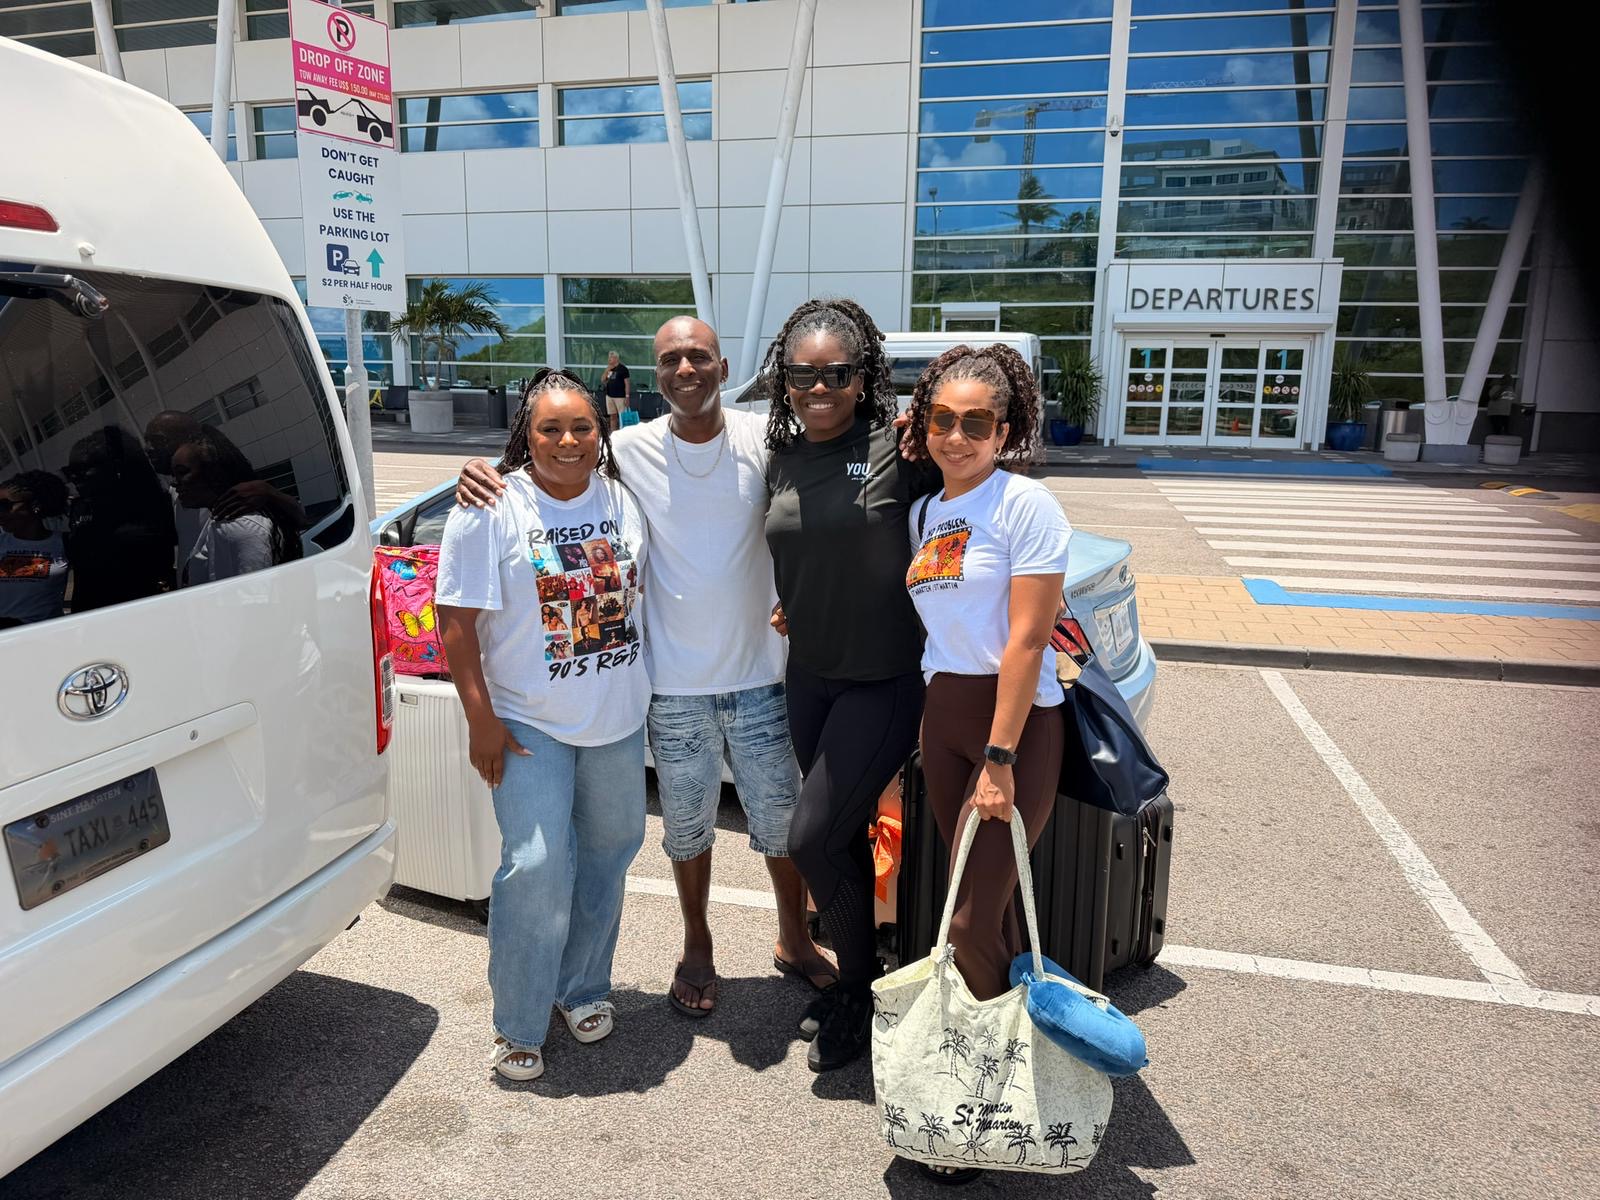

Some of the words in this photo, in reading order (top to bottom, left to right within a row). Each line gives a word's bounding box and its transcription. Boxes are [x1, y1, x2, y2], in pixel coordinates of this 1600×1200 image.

[299, 48, 331, 69] DROP
[335, 58, 354, 76] OFF
[358, 64, 385, 84] ZONE
[299, 69, 312, 81] TOW
[313, 72, 329, 85] AWAY
[329, 77, 338, 88] FEE
[321, 147, 356, 164] DON'T
[359, 155, 379, 168] GET
[328, 168, 375, 186] CAUGHT
[333, 207, 353, 220] USE
[356, 211, 375, 223] THE
[319, 224, 368, 241] PARKING
[370, 231, 390, 243] LOT
[321, 278, 333, 287] $2
[333, 279, 348, 288] PER
[349, 280, 369, 290] HALF
[370, 282, 393, 292] HOUR
[1130, 287, 1315, 311] DEPARTURES
[846, 462, 871, 476] YOU
[600, 520, 619, 536] ON
[937, 516, 968, 533] PROBLEM
[548, 657, 590, 682] 90'S
[596, 642, 640, 675] R&B
[50, 808, 73, 824] SINT
[75, 787, 121, 815] MAARTEN
[63, 815, 110, 857] TAXI
[128, 796, 160, 829] 445
[952, 1103, 974, 1127] St
[978, 1101, 1013, 1117] Martin
[975, 1117, 1022, 1132] Maarten
